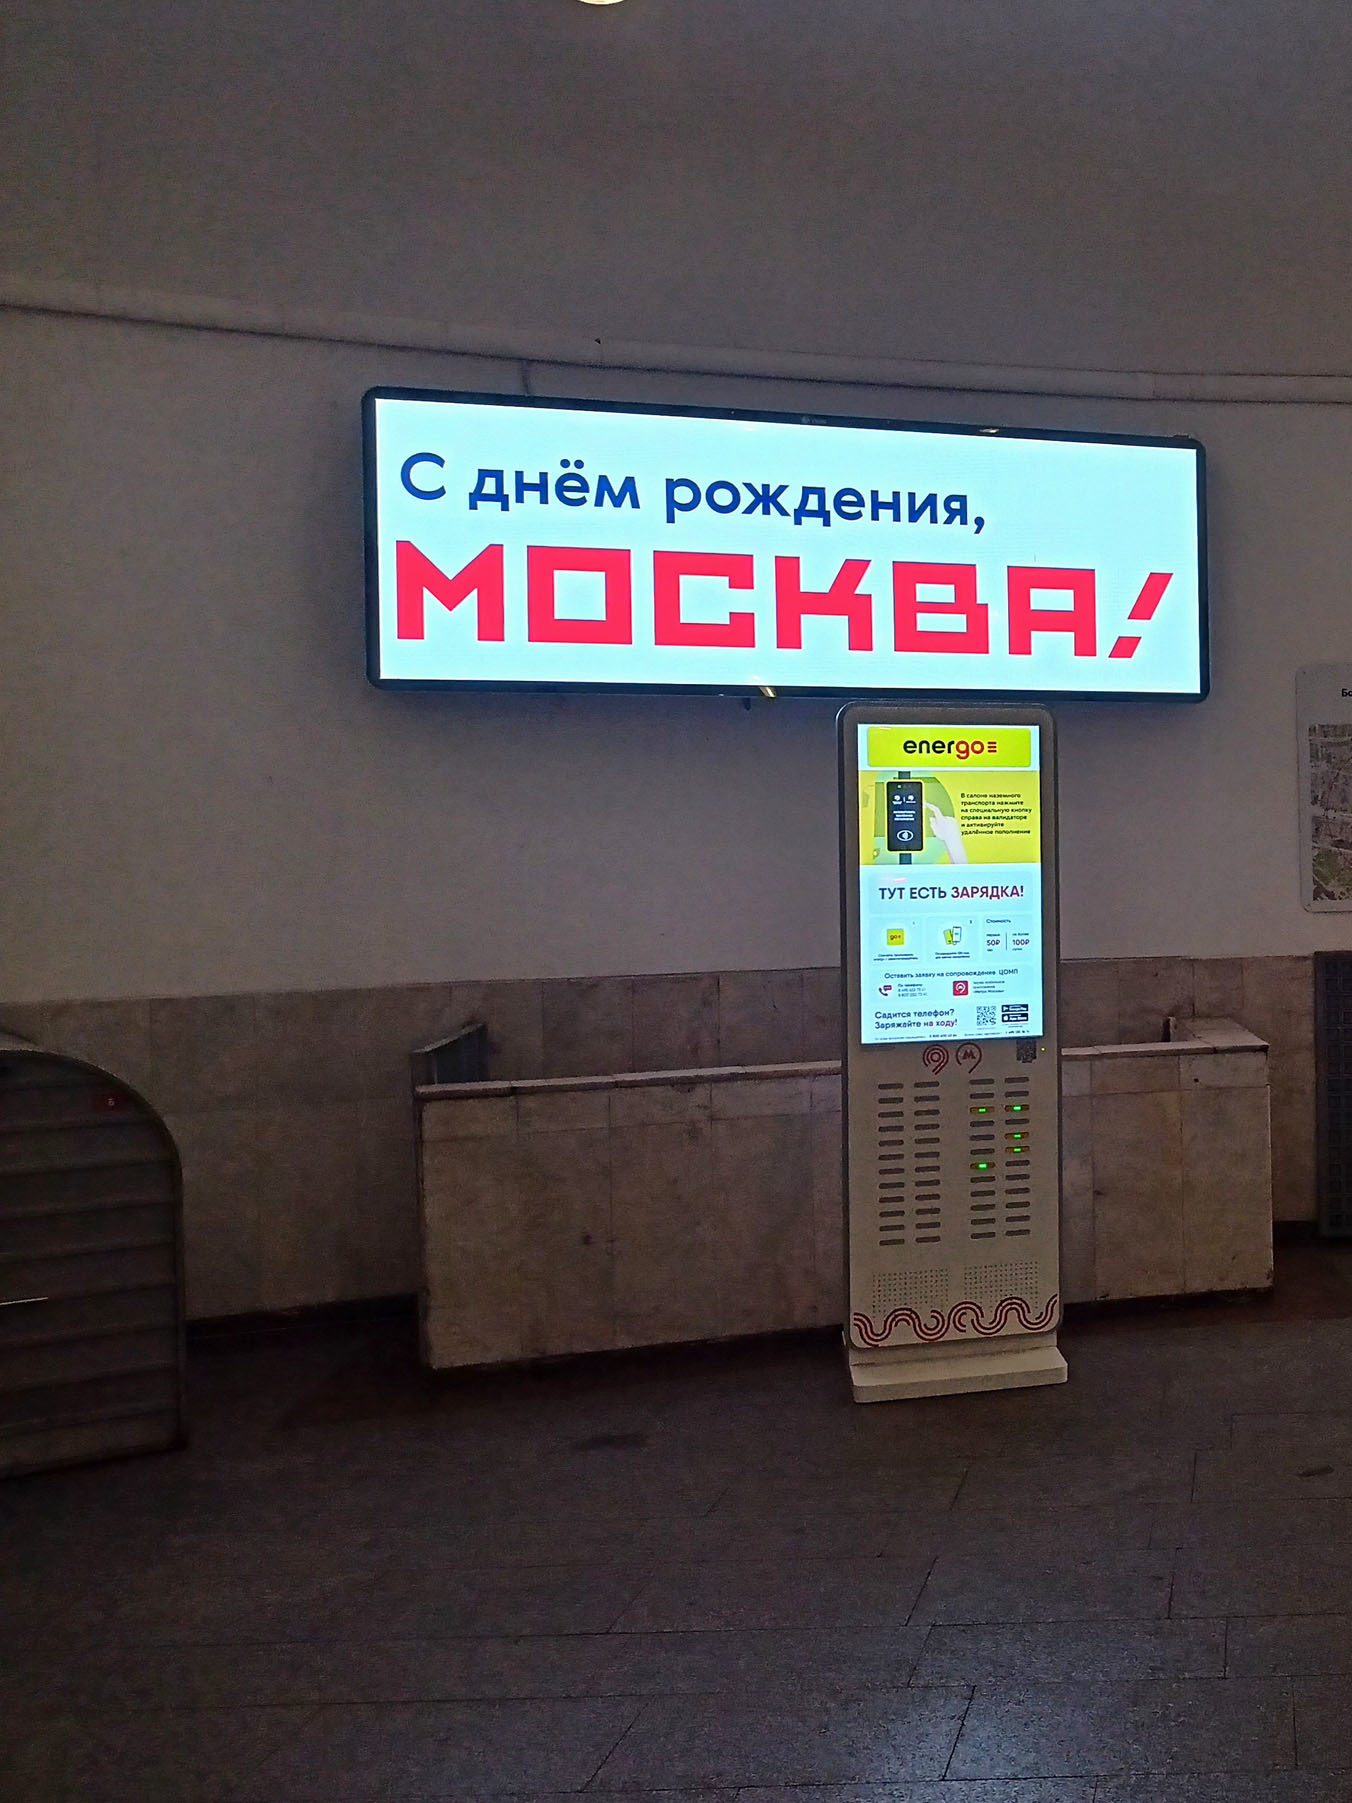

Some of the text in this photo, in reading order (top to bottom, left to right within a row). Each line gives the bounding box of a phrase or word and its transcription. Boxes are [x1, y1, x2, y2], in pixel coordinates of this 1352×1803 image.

[400, 453, 986, 535] С днём рождения,
[396, 539, 1175, 660] МОСКВА!
[903, 740, 985, 760] energo
[879, 886, 1025, 901] ТУТ ЕСТЬ ЗАРЯДКА!
[874, 1009, 955, 1020] Садится телефон?
[874, 1020, 922, 1030] Заряжайте
[935, 1018, 958, 1028] ходу!
